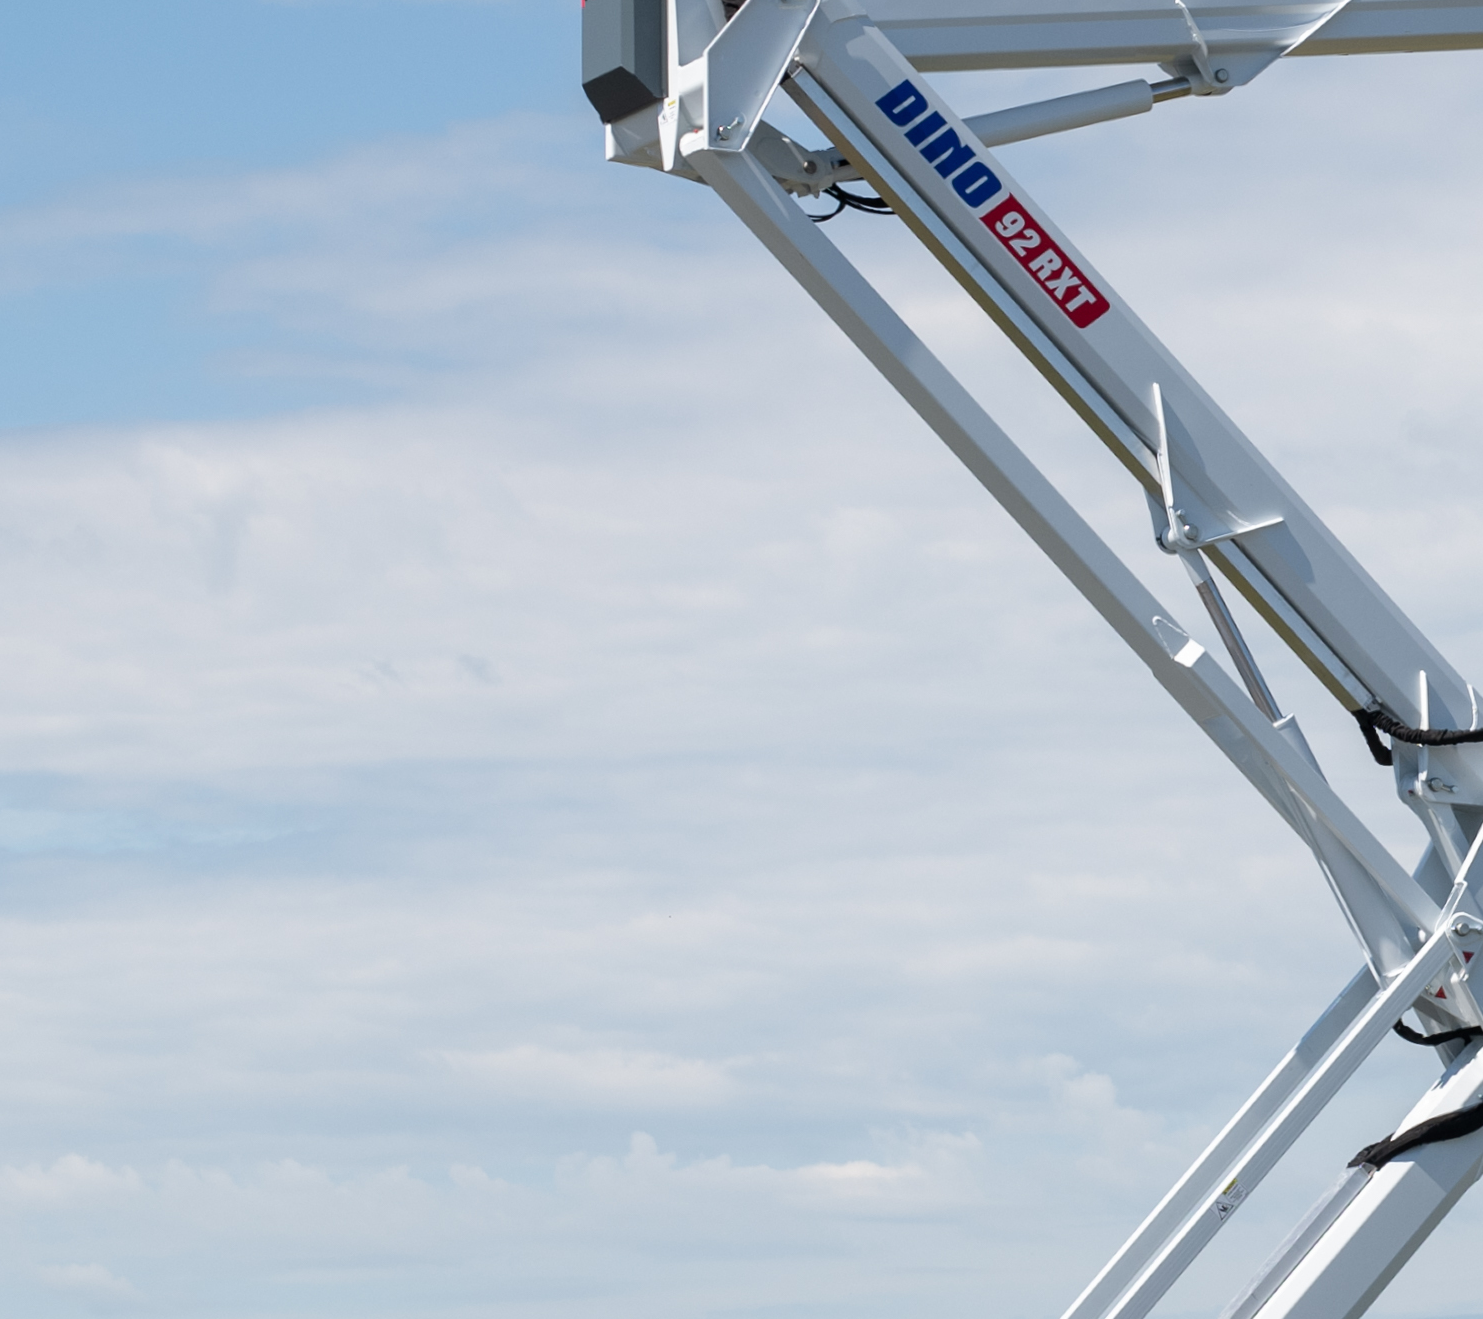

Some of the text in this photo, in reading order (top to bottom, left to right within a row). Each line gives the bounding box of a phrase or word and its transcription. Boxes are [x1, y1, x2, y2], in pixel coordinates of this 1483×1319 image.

[874, 79, 1097, 314] DINO 92 RXT
